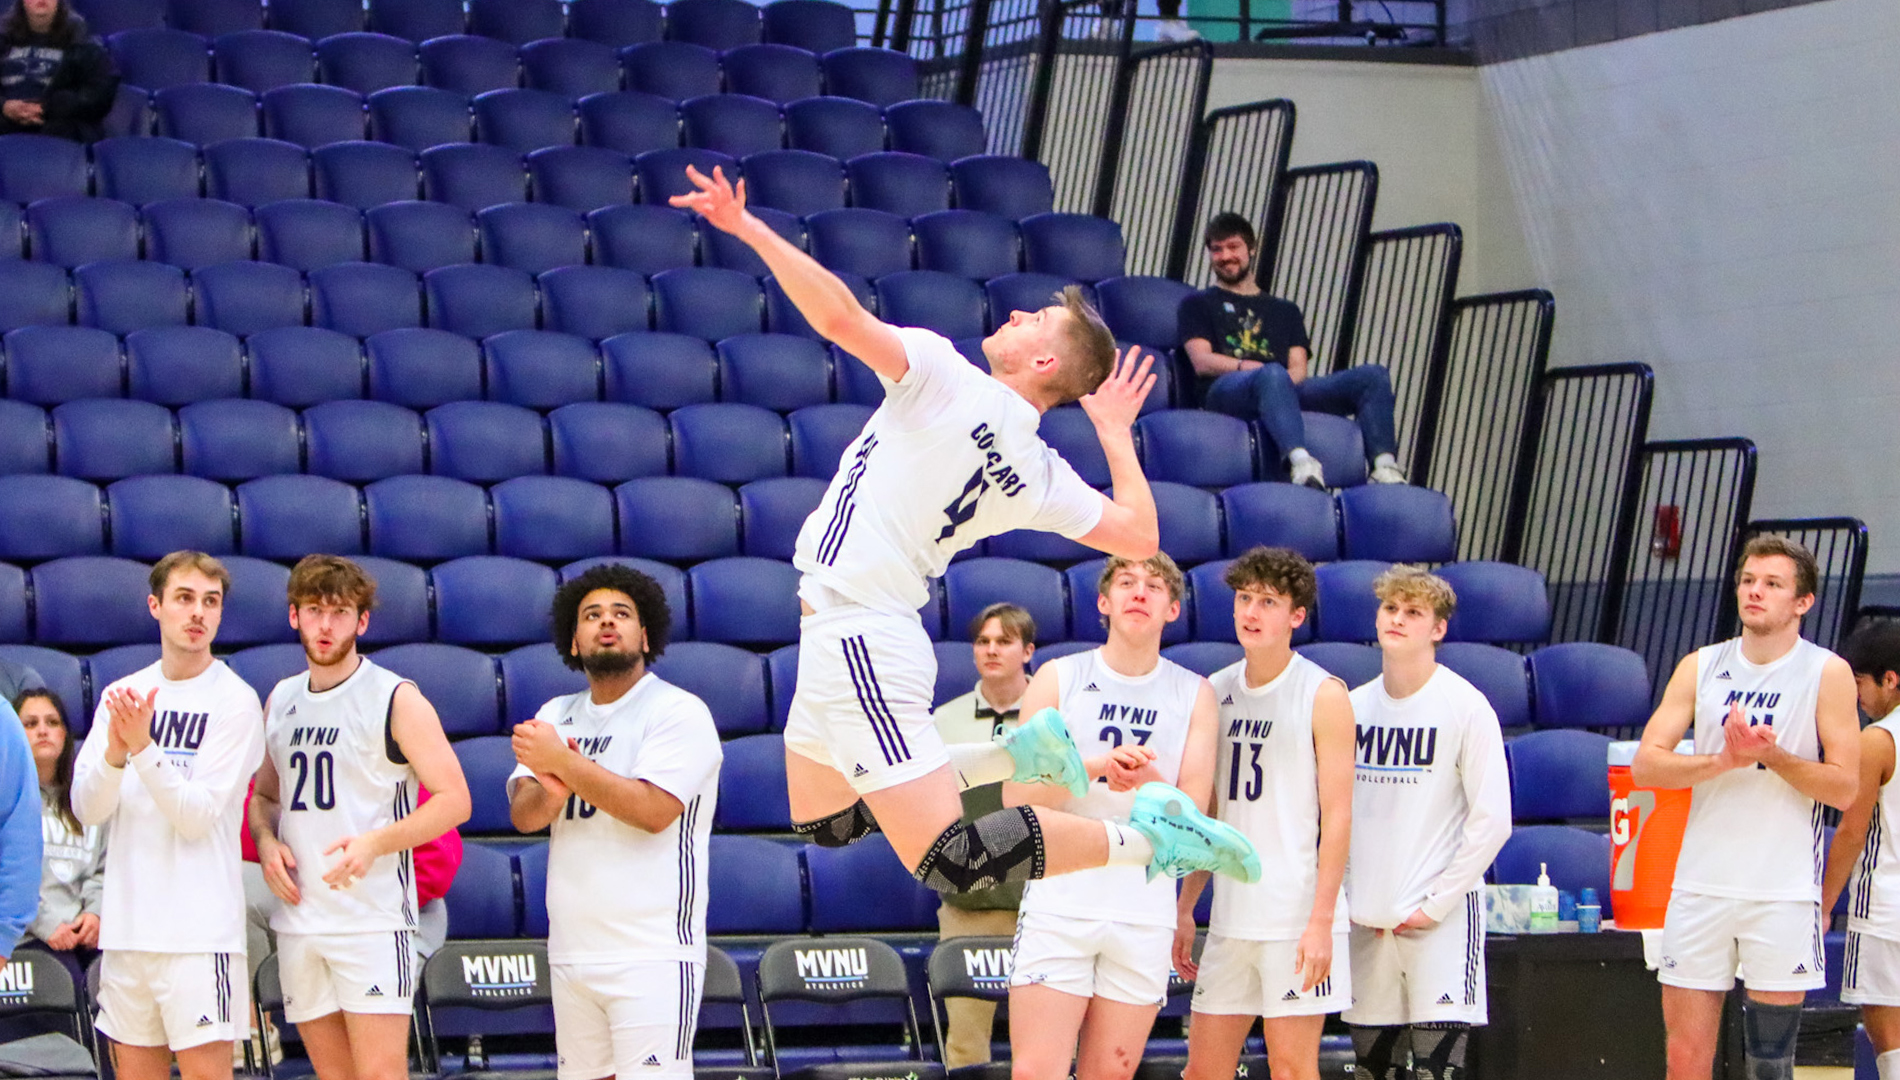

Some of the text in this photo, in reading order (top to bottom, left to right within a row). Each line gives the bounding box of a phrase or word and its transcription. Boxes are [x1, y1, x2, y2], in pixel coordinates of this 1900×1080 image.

[970, 422, 1027, 498] COGARS
[934, 465, 990, 544] 4
[1722, 689, 1782, 709] MVNU
[149, 709, 209, 749] VNU
[1098, 703, 1158, 726] MVNU
[1227, 718, 1273, 739] MVNU
[289, 726, 340, 747] MVNU
[1354, 724, 1437, 766] MVNU
[289, 750, 336, 811] 20
[1228, 741, 1263, 802] 13
[1356, 774, 1418, 784] VOLLEYBALL
[1610, 797, 1630, 846] G
[0, 961, 33, 992] NU
[461, 954, 536, 984] MVNU
[794, 948, 868, 977] MVNU
[963, 948, 1013, 977] MVN
[471, 988, 532, 997] ATHLETICS
[805, 981, 864, 990] ATHLETICS
